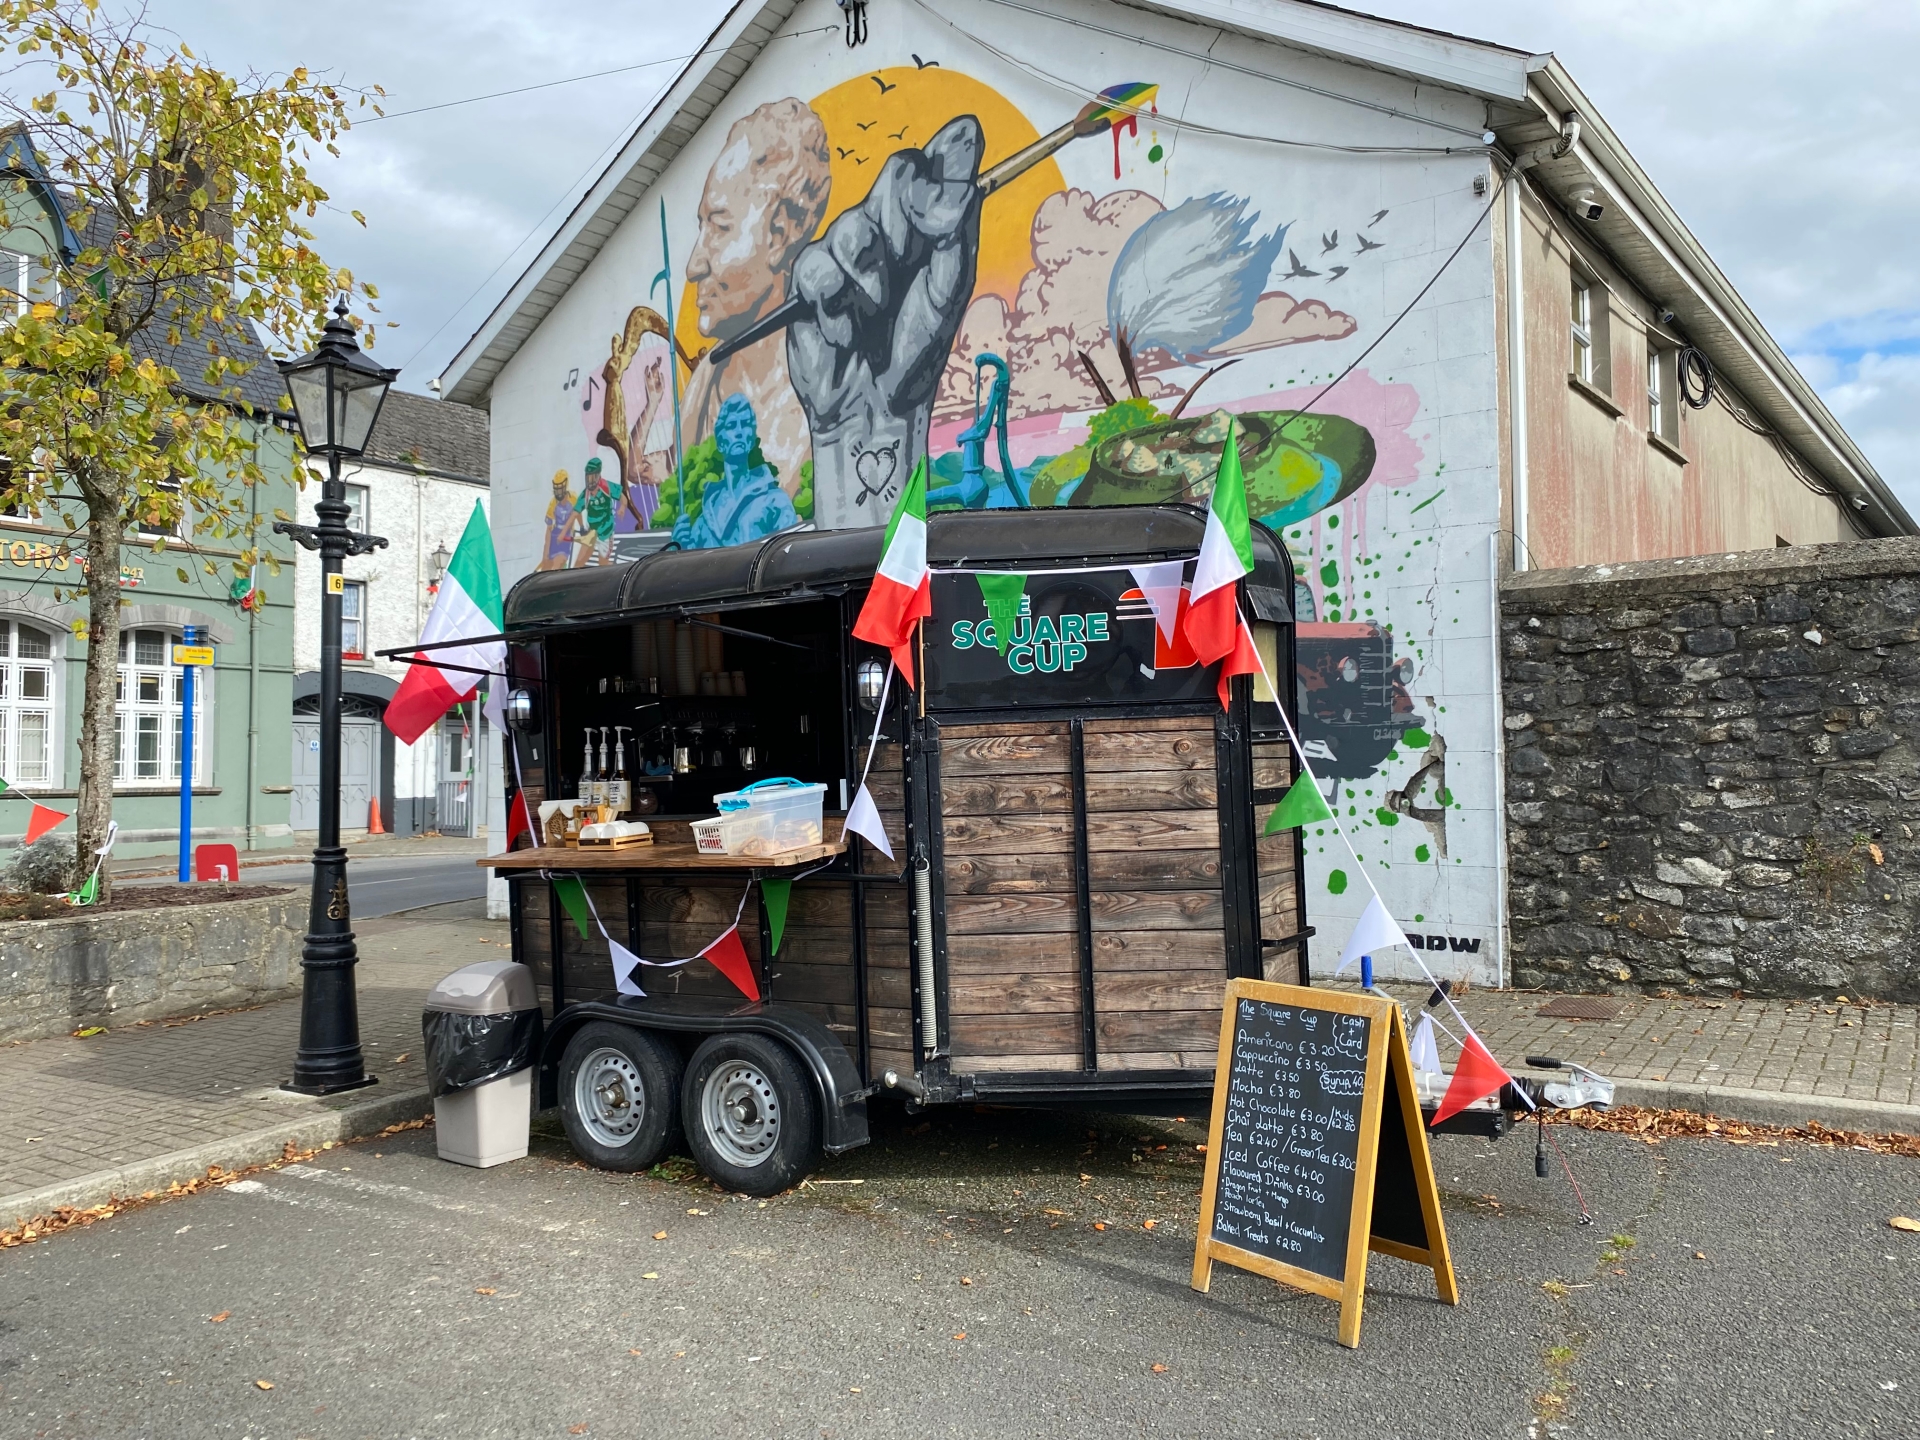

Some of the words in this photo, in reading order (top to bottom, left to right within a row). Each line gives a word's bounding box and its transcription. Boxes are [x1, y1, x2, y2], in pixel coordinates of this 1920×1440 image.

[335, 578, 341, 590] 6
[983, 594, 1031, 618] THE
[952, 612, 1109, 650] SQUARE
[1008, 643, 1087, 674] CUP
[1239, 1000, 1255, 1014] The
[1260, 1003, 1291, 1021] Square
[1300, 1009, 1318, 1027] Cup
[1342, 1015, 1365, 1028] Cash
[1238, 1029, 1294, 1051] Americano
[1339, 1033, 1363, 1049] Card
[1236, 1045, 1290, 1066] Cappuccino
[1235, 1061, 1264, 1077] Latte
[1232, 1078, 1263, 1095] Mocha
[1230, 1093, 1245, 1108] Hot
[1249, 1098, 1296, 1118] Chocolate
[1335, 1109, 1354, 1123] Kids
[1226, 1123, 1242, 1142] Tea
[1227, 1109, 1250, 1126] Chai
[1256, 1114, 1283, 1135] Latte
[1225, 1142, 1248, 1163] Iced
[1256, 1151, 1290, 1174] Coffee
[1223, 1160, 1262, 1184] Flavoured
[1265, 1172, 1294, 1194] Drinks
[1225, 1177, 1245, 1192] Dragon
[1248, 1183, 1262, 1194] Fruit
[1216, 1213, 1241, 1238] Baked
[1244, 1226, 1269, 1244] Treats
[1224, 1201, 1261, 1226] Strawberry
[1264, 1212, 1282, 1228] Basil
[1290, 1221, 1325, 1243] Cucumber
